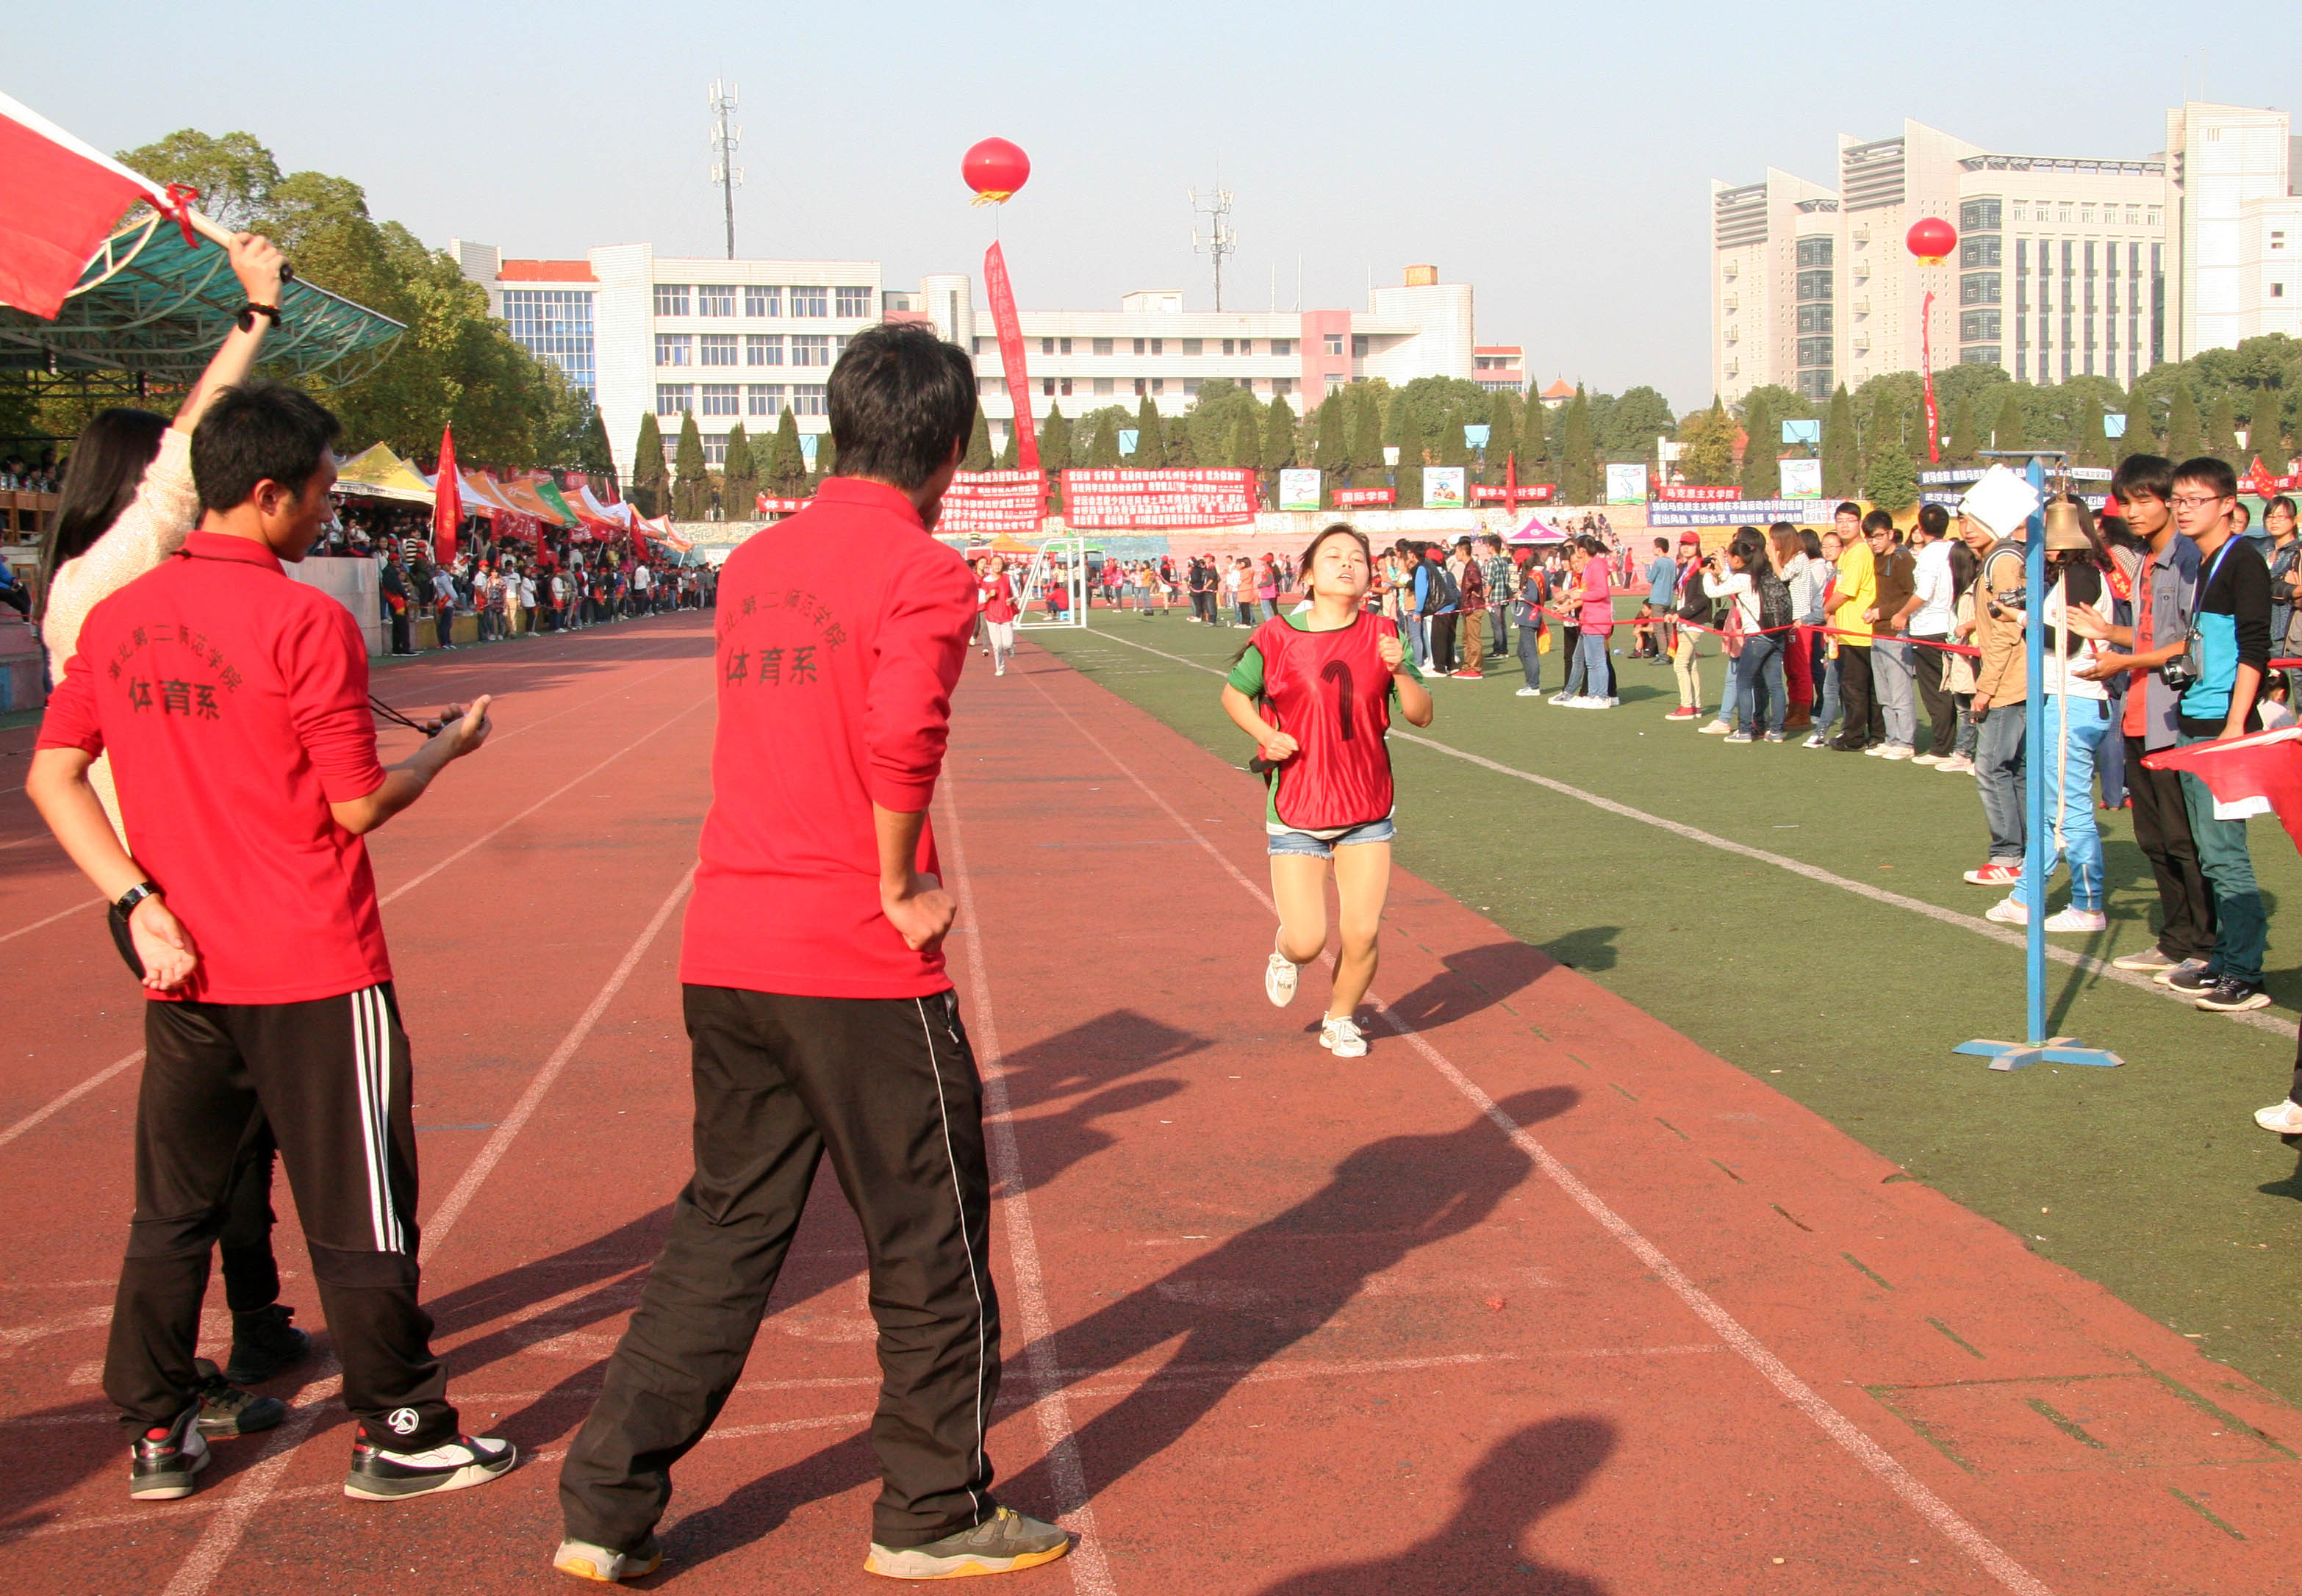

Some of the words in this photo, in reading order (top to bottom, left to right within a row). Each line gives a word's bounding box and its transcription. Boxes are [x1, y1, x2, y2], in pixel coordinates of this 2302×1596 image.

[1342, 492, 1388, 502] 国际学院
[1477, 487, 1546, 497] 数学与计学院
[1667, 489, 1735, 499] 马克思主义学院
[726, 645, 818, 688] 体育系
[129, 677, 220, 720] 体育系
[1321, 660, 1353, 741] 1
